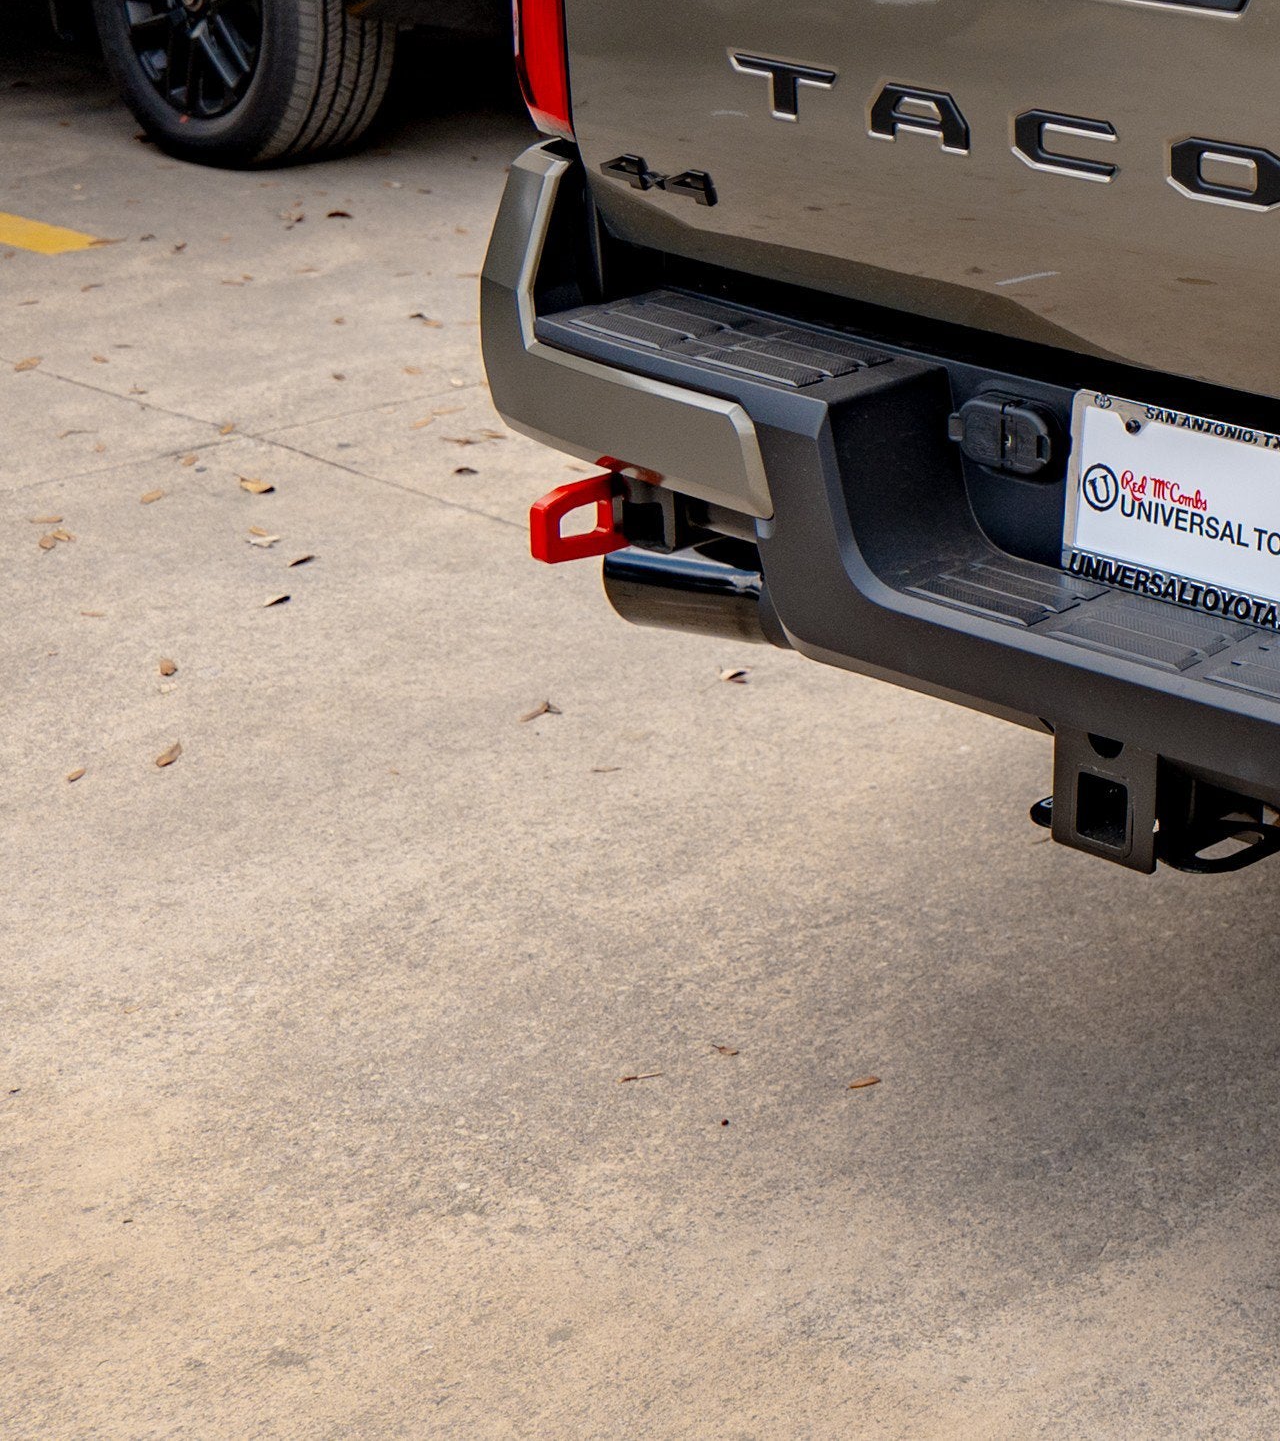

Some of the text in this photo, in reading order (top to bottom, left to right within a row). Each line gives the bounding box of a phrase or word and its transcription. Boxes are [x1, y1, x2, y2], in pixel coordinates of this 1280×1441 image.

[1145, 406, 1177, 425] SAN
[1181, 415, 1259, 446] ANTONIO,
[1120, 469, 1208, 512] Red McCombs
[1120, 493, 1250, 548] UNIVERSAL
